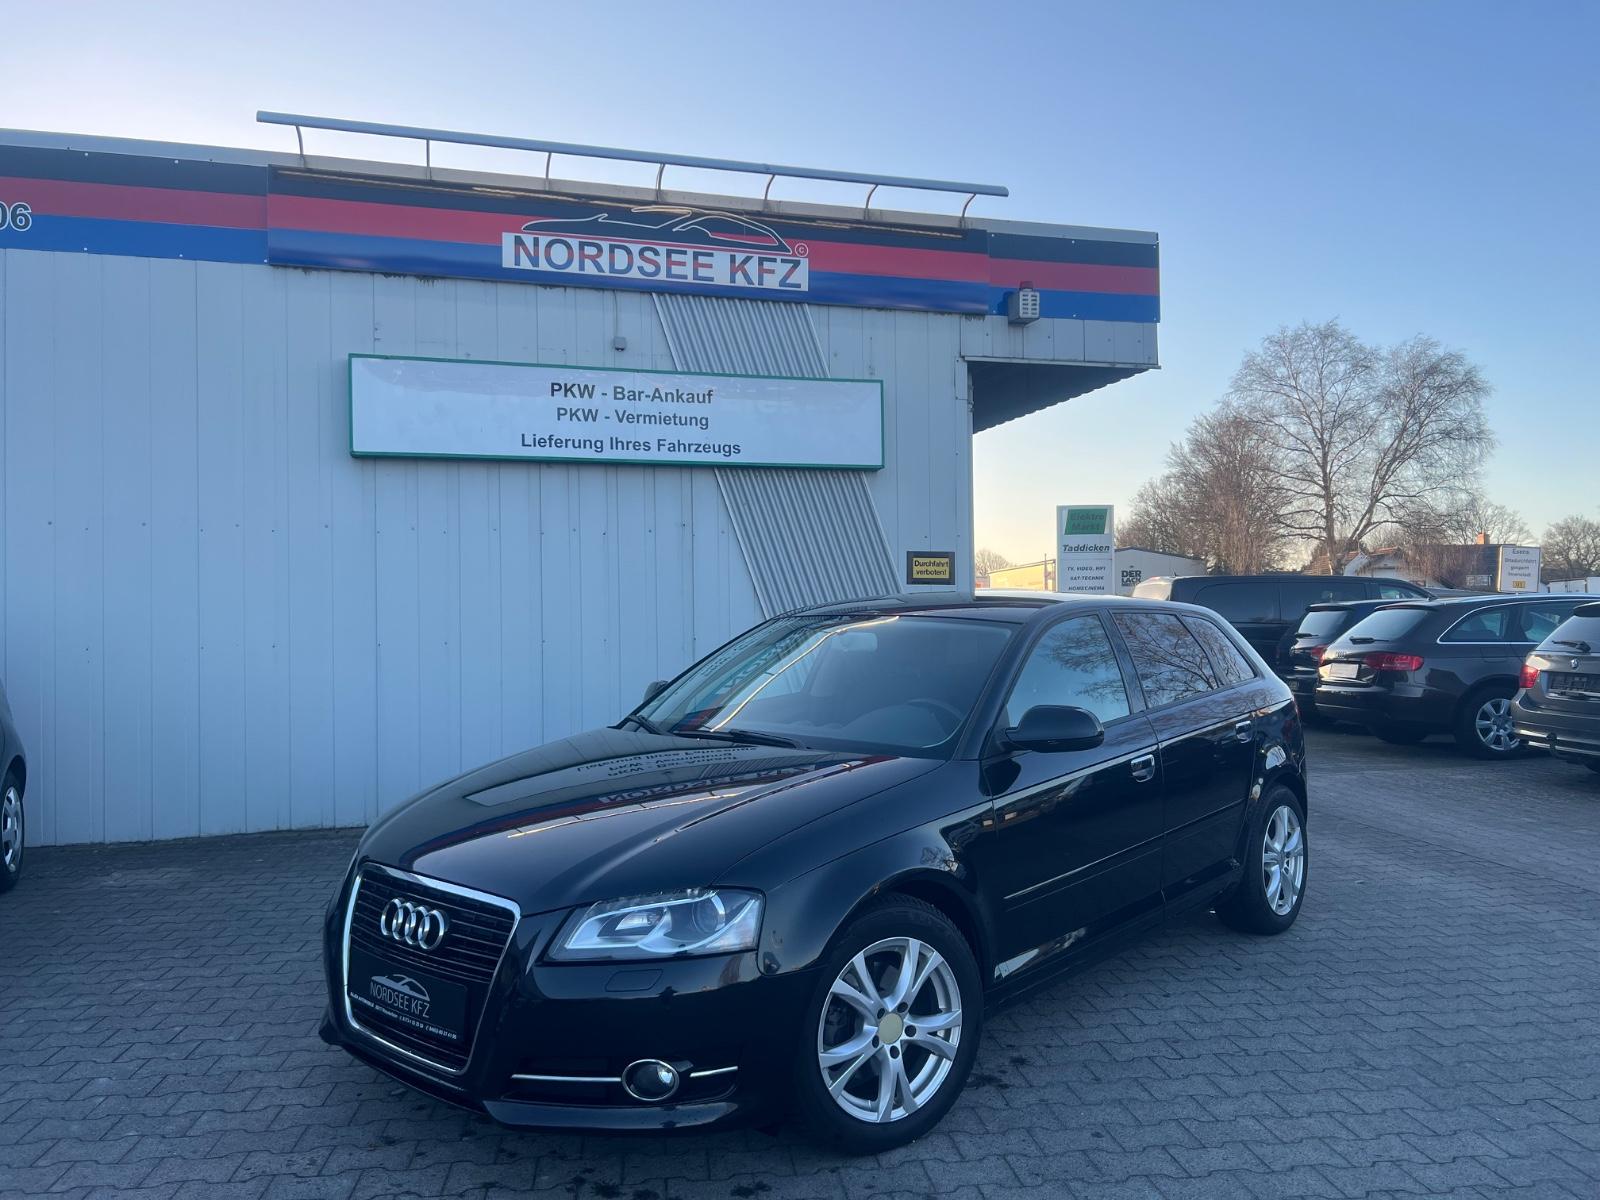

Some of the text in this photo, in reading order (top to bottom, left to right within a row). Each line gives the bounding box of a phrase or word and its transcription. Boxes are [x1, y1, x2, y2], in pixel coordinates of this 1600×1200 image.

[513, 234, 715, 283] NORDSEE
[729, 253, 802, 289] KFZ
[550, 382, 596, 400] PKW
[613, 385, 714, 404] Bar-Ankauf
[556, 407, 599, 422] PKW
[615, 409, 710, 430] Vermietung
[521, 433, 742, 457] Lieferung Ihres Fahrzeugs
[1062, 544, 1110, 552] Taddicken
[914, 560, 949, 568] Durchfahrt
[1121, 570, 1142, 578] DER
[370, 981, 409, 1011] NORDSEE
[411, 998, 431, 1019] KFZ
